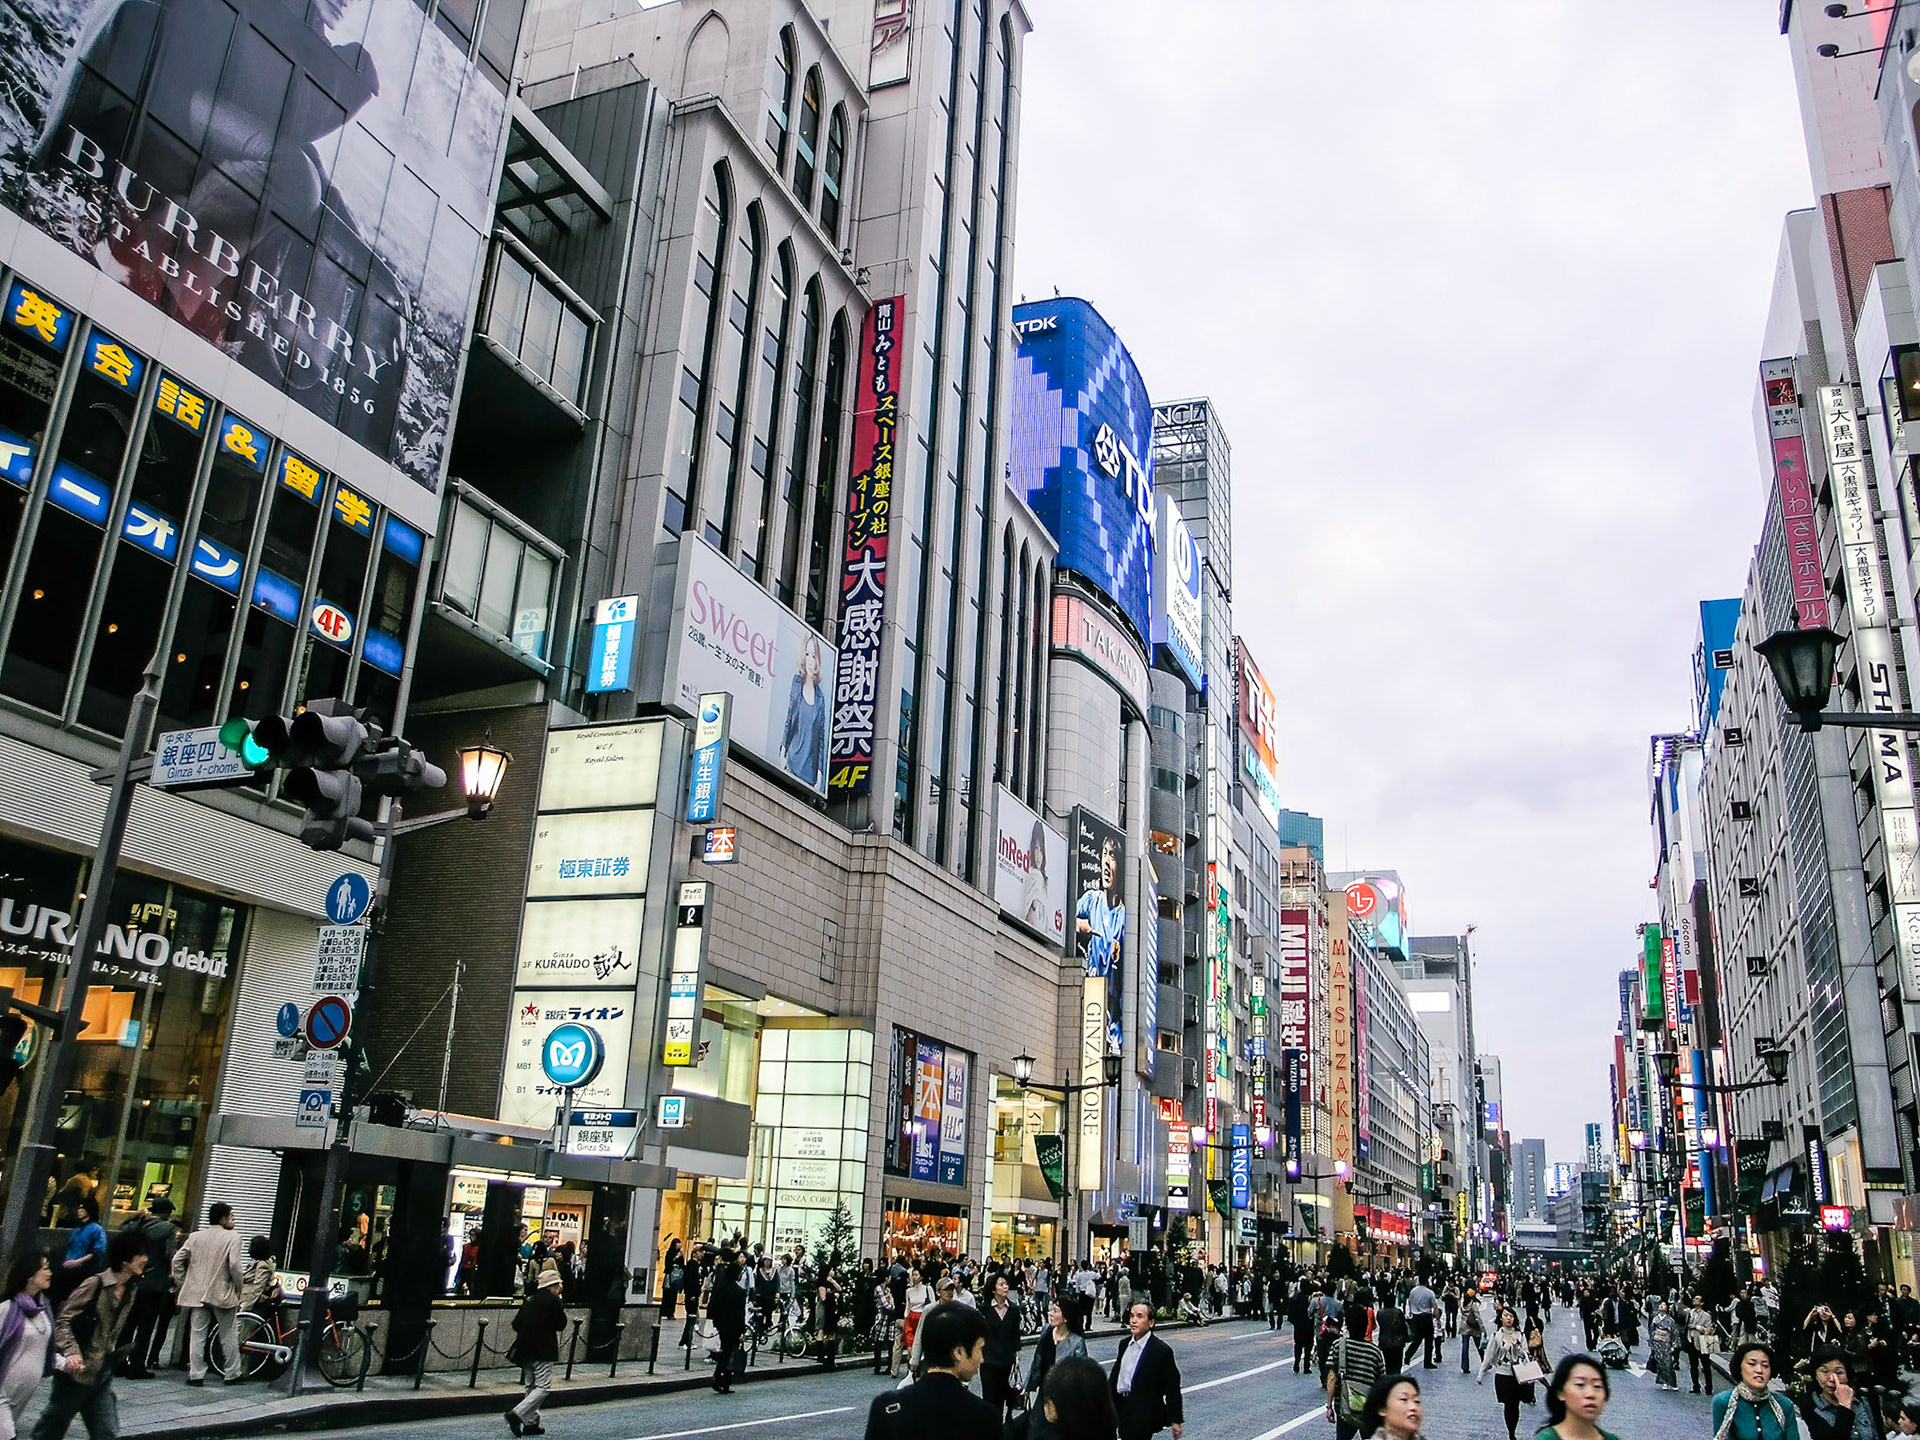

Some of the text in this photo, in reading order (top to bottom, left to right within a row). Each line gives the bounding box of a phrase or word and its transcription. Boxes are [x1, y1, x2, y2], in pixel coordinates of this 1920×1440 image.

[59, 124, 392, 386] BURBERRY
[57, 181, 376, 416] ESTABLISHED 1856
[1015, 315, 1058, 334] TDK
[1768, 367, 1789, 376] 九州
[1830, 388, 1844, 408] 銀座
[1829, 409, 1858, 459] 大黒屋
[853, 474, 872, 547] オープン
[1840, 464, 1863, 541] 大黒屋ギャラリー
[1854, 546, 1876, 627] 大黒屋ギャラリー
[316, 607, 346, 639] 4F
[690, 579, 779, 678] Sweet
[599, 623, 623, 688] 極東証券
[831, 549, 887, 755] 大感謝祭
[1083, 617, 1138, 687] TAKANO
[165, 731, 195, 744] 中央区
[161, 741, 242, 767] 銀座四丁
[167, 762, 239, 778] Ginza 4-chome
[692, 748, 715, 819] 新生銀行
[829, 766, 869, 788] 4F
[538, 831, 549, 839] 6F
[712, 828, 735, 854] 本
[998, 828, 1031, 874] InRed
[534, 864, 544, 872] 5F
[558, 856, 630, 879] 極東証券
[1682, 918, 1692, 956] docomo
[171, 946, 228, 979] debut
[522, 961, 532, 969] 3F
[534, 958, 591, 969] KURAUDO
[1281, 924, 1307, 993] MUJI
[522, 1039, 532, 1047] 9F
[516, 1062, 532, 1070] MB1
[1081, 1001, 1103, 1136] GINZA CORE
[919, 1064, 943, 1120] 本
[576, 1143, 598, 1151] Ginza
[577, 1130, 614, 1143] 銀座駅
[1232, 1135, 1248, 1198] FANCL
[1808, 1139, 1824, 1201] WASHINGTON
[780, 1193, 834, 1204] GINZA CORE
